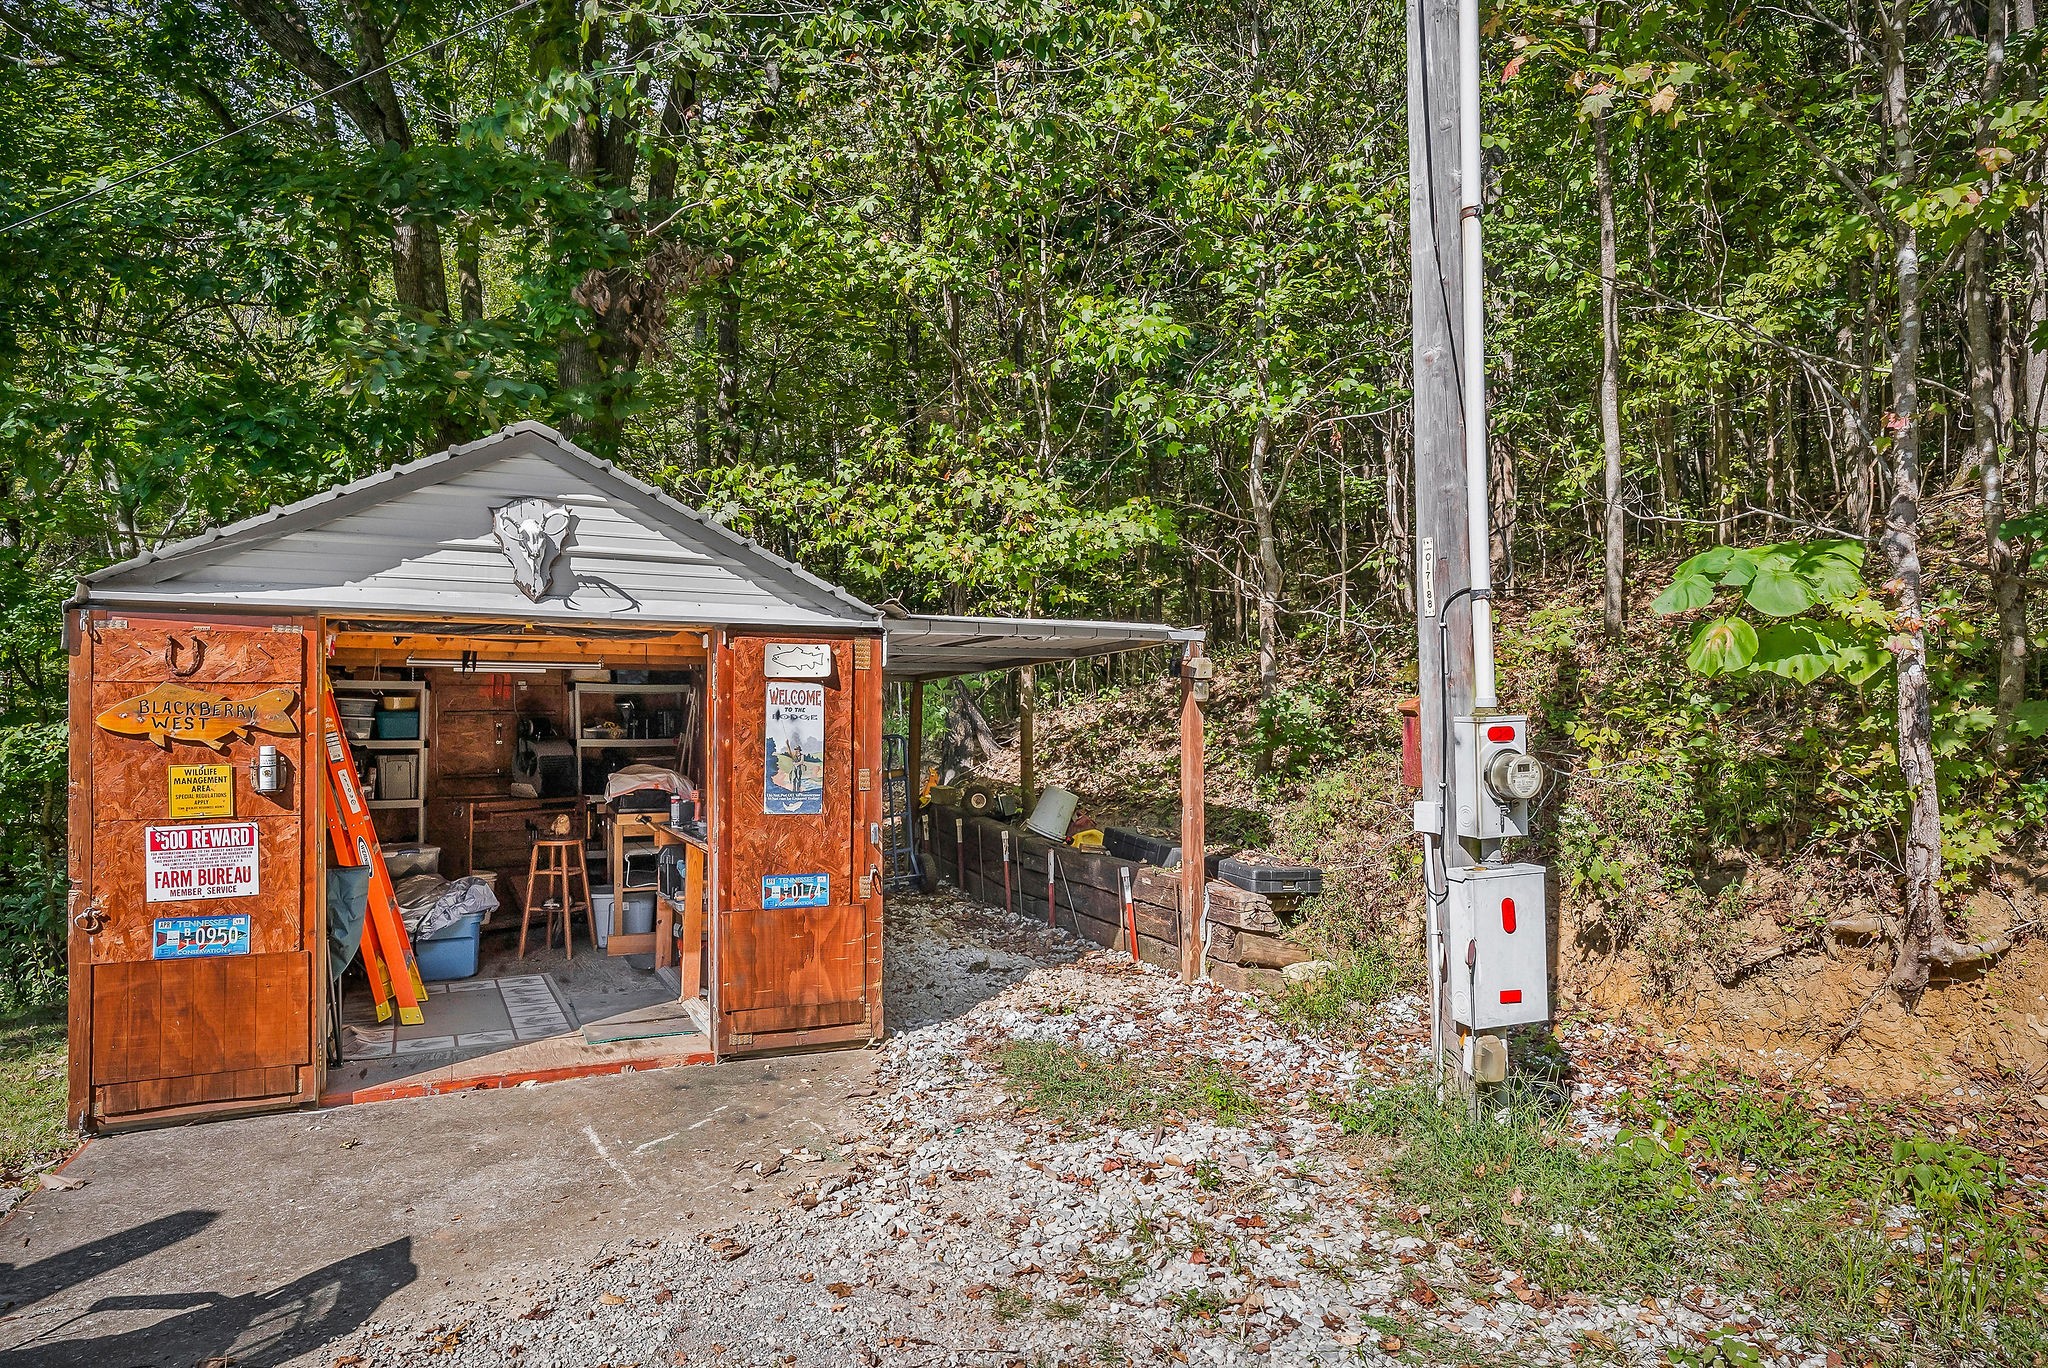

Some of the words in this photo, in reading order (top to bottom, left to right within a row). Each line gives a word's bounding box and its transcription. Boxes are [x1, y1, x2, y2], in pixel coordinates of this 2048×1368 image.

[769, 688, 822, 706] WELCOME
[138, 700, 256, 718] BLACKBERRY
[152, 716, 210, 730] WEST
[174, 776, 228, 784] MANAGEMENT
[184, 768, 218, 776] WILDLIFE
[155, 830, 188, 850] $500
[192, 828, 250, 849] REWARD
[155, 870, 192, 889] FARM
[198, 866, 251, 887] BUREAU
[170, 888, 202, 897] MEMBER
[207, 885, 237, 895] SERVICE
[792, 883, 821, 899] 0174
[177, 920, 229, 928] TENNESSEE
[196, 926, 238, 945] 0950
